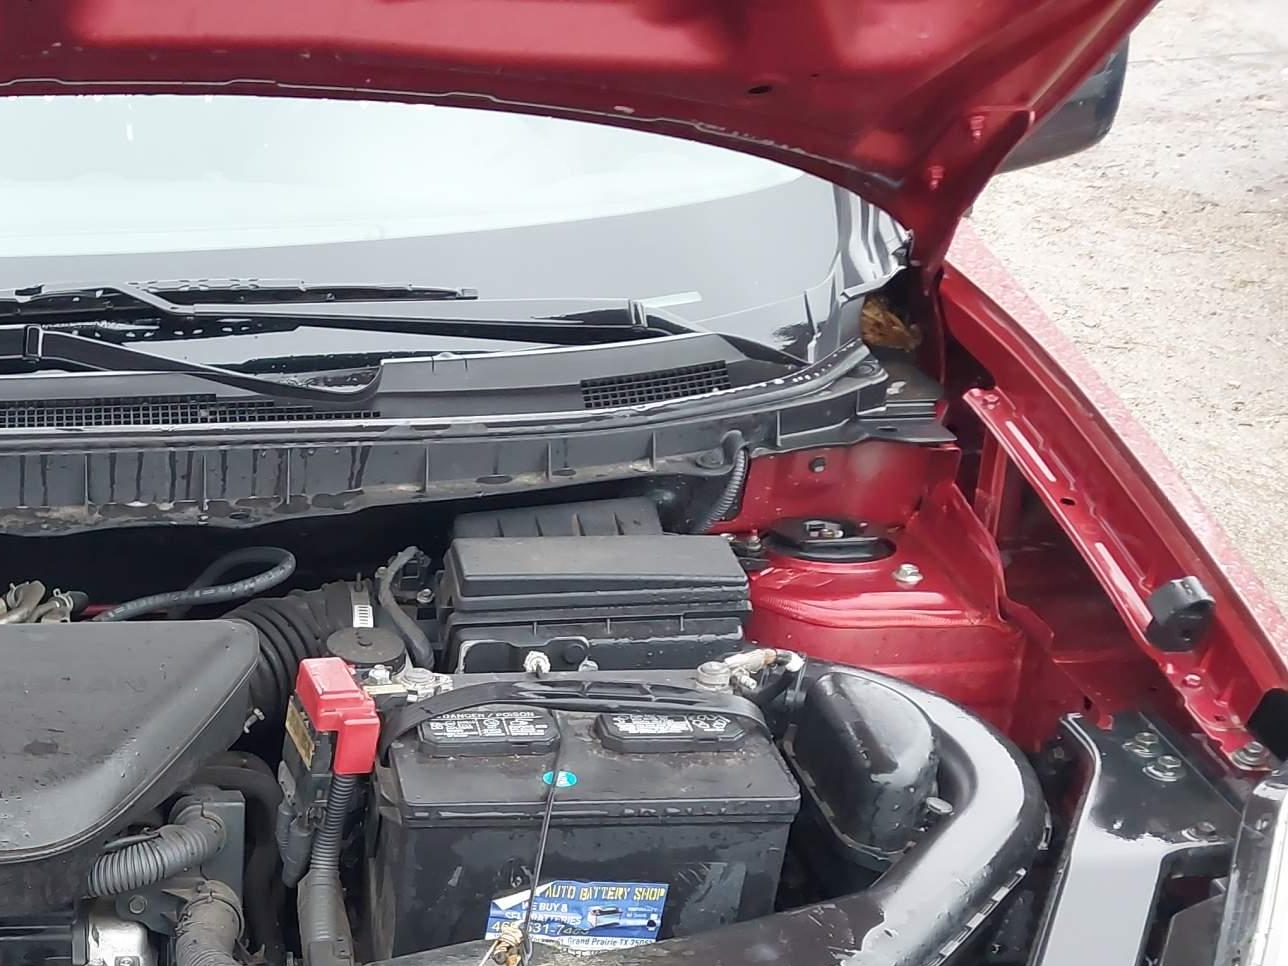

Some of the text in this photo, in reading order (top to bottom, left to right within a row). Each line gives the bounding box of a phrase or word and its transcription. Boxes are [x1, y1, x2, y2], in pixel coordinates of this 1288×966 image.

[545, 885, 666, 900] AUTO BATTERY SHOP
[539, 903, 559, 911] BUY
[568, 937, 590, 945] Grand
[591, 938, 617, 946] Prairie
